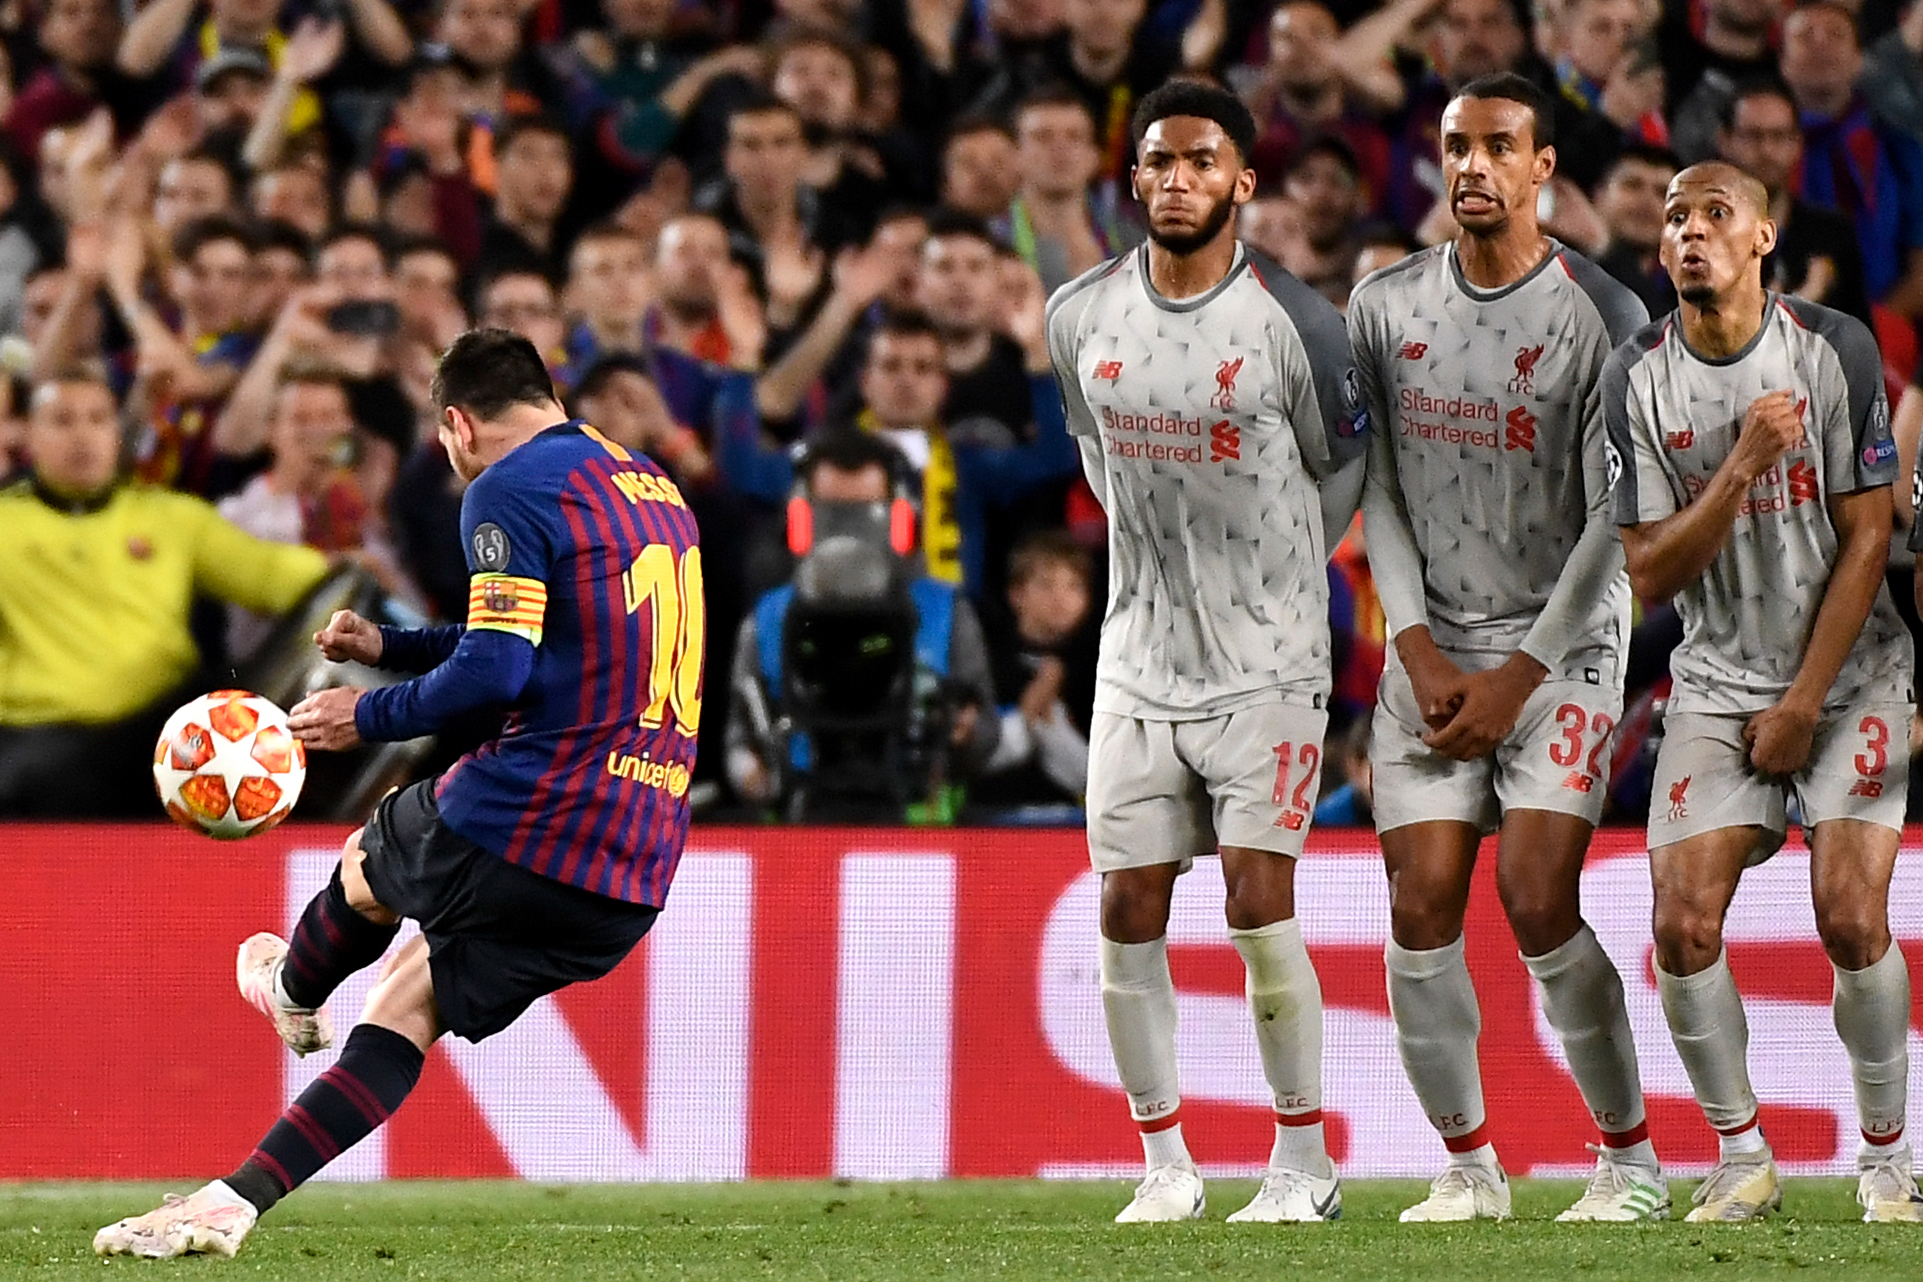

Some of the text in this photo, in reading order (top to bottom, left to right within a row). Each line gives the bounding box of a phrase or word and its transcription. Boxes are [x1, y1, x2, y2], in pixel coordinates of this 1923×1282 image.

[1102, 405, 1201, 437] Standard
[1401, 388, 1499, 423] Standard
[1104, 434, 1202, 463] Chartered
[486, 547, 497, 562] 5
[623, 544, 704, 739] 10
[1549, 703, 1614, 779] 32
[1854, 715, 1889, 777] 3
[607, 751, 674, 789] unicef
[1272, 741, 1319, 813] 12
